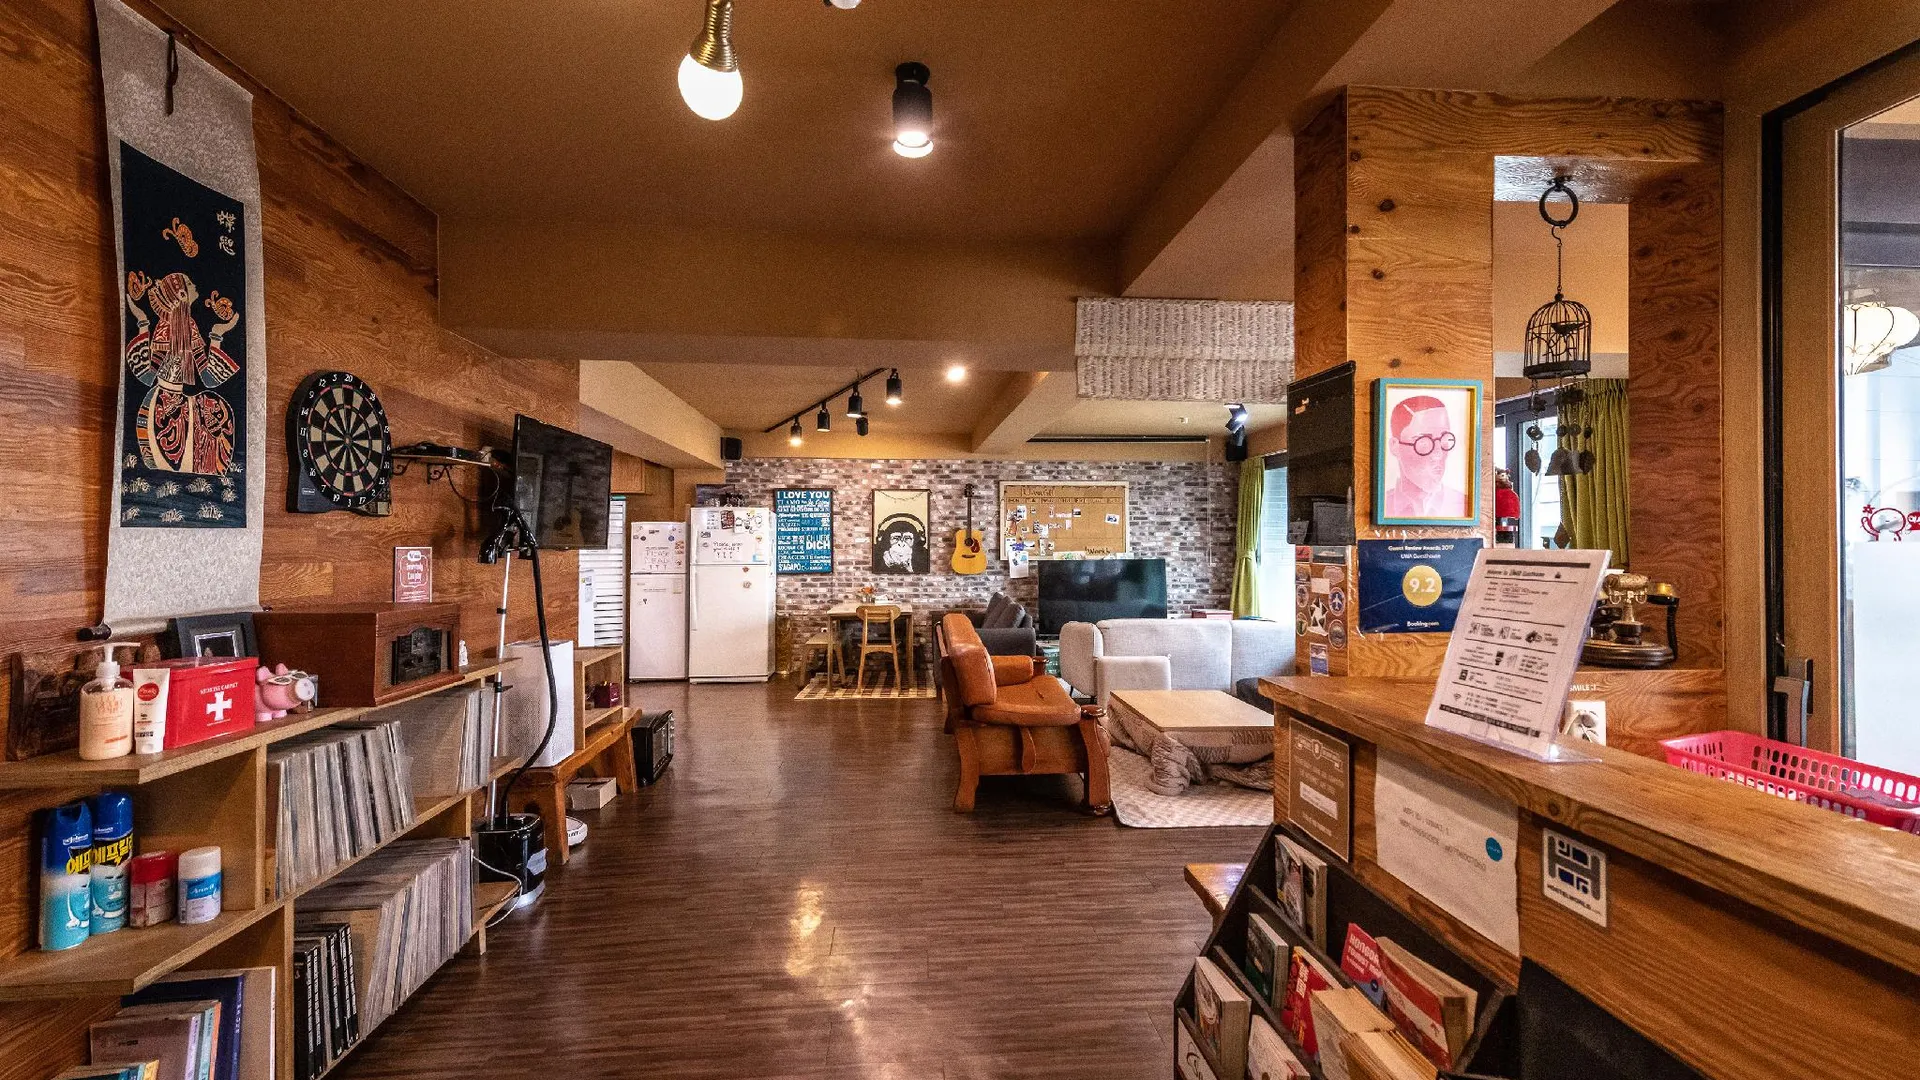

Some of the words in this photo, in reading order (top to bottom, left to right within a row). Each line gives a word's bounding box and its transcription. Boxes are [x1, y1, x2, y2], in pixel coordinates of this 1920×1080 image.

[332, 374, 338, 382] 5
[344, 373, 353, 383] 20
[318, 378, 326, 388] 12
[308, 390, 315, 399] 9
[300, 407, 309, 416] 14
[299, 427, 307, 437] 11
[302, 450, 308, 458] 8
[309, 467, 317, 478] 16
[320, 485, 327, 493] 7
[371, 489, 376, 497] 2
[783, 491, 807, 499] LOVE
[809, 491, 830, 499] YOU
[347, 498, 352, 508] 3
[359, 496, 367, 505] 17
[806, 541, 830, 550] DICH
[1409, 577, 1436, 593] 9.2
